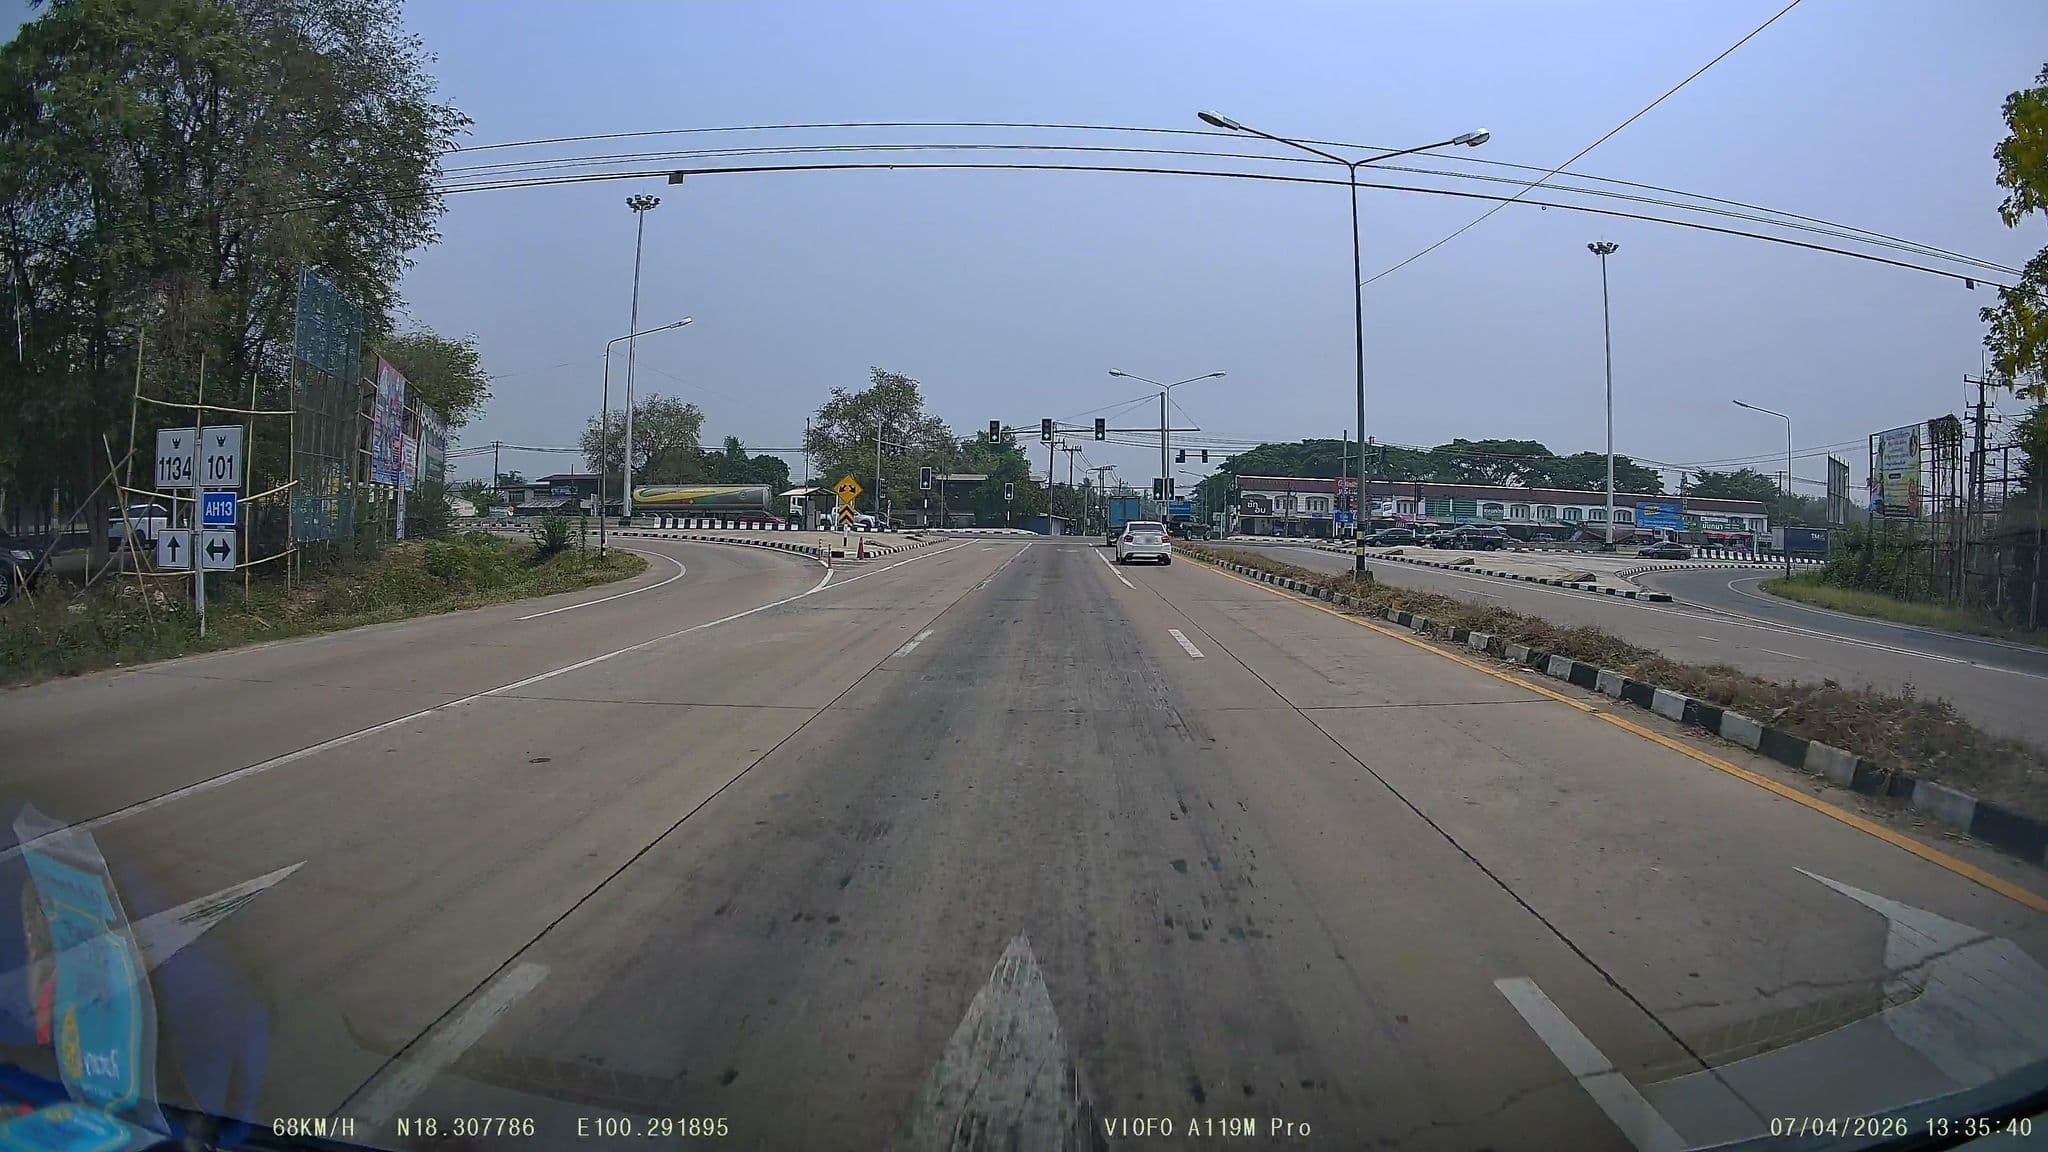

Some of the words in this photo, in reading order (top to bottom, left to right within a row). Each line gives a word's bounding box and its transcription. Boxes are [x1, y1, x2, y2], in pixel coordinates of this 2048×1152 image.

[159, 456, 192, 481] 1134
[208, 454, 233, 480] 101
[205, 500, 233, 517] AH13
